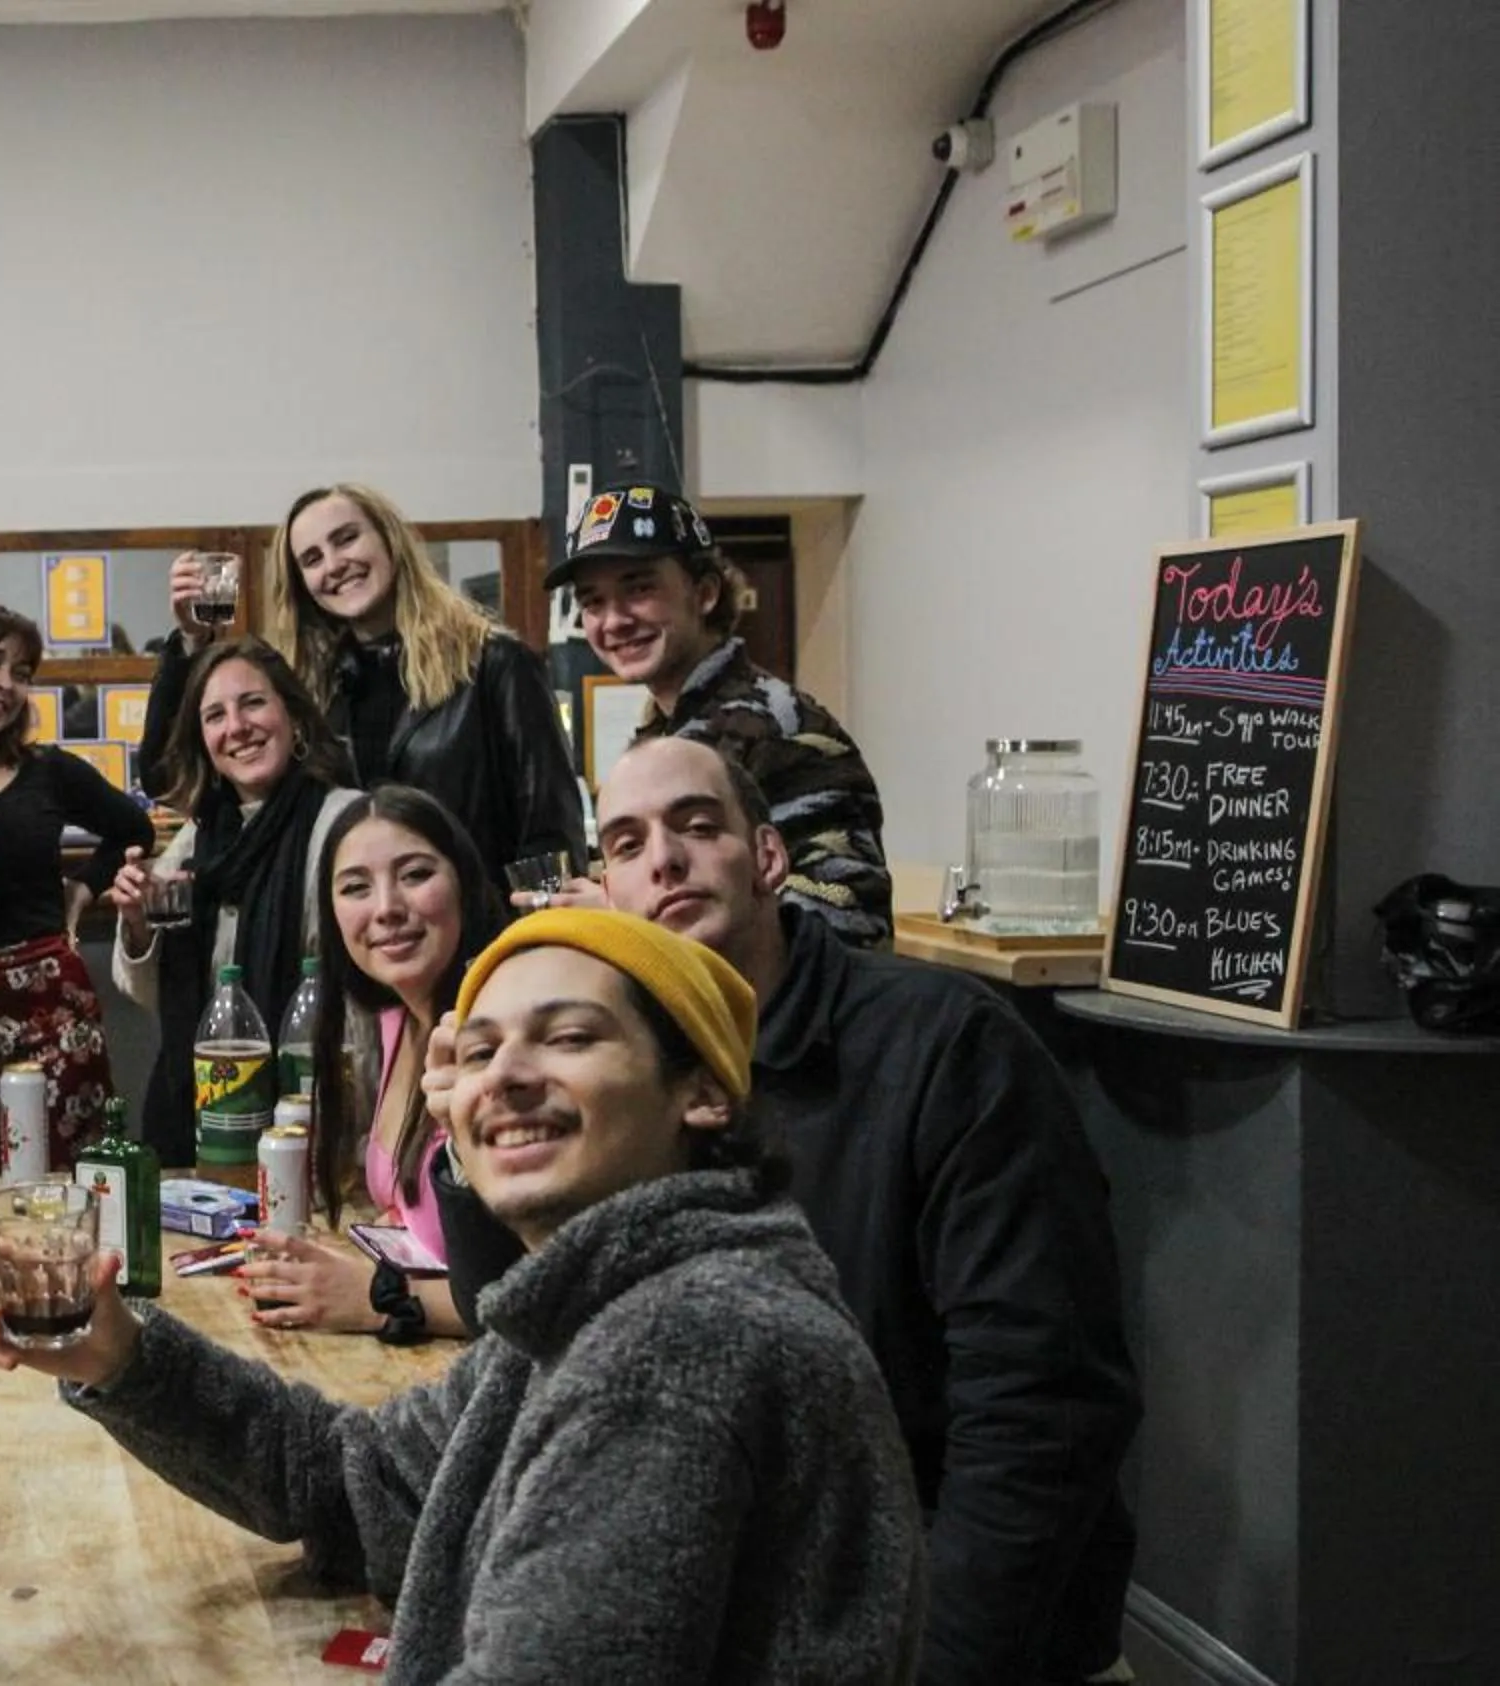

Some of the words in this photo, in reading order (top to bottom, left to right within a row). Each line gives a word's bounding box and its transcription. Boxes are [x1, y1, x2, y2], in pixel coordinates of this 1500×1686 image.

[1164, 556, 1323, 650] Today's
[1154, 622, 1299, 677] Activities
[1269, 707, 1321, 730] WALK
[1206, 761, 1267, 791] FREE
[1208, 788, 1290, 826] DINNER
[1206, 837, 1297, 867] DRINKING
[1210, 947, 1284, 981] KITCHEN
